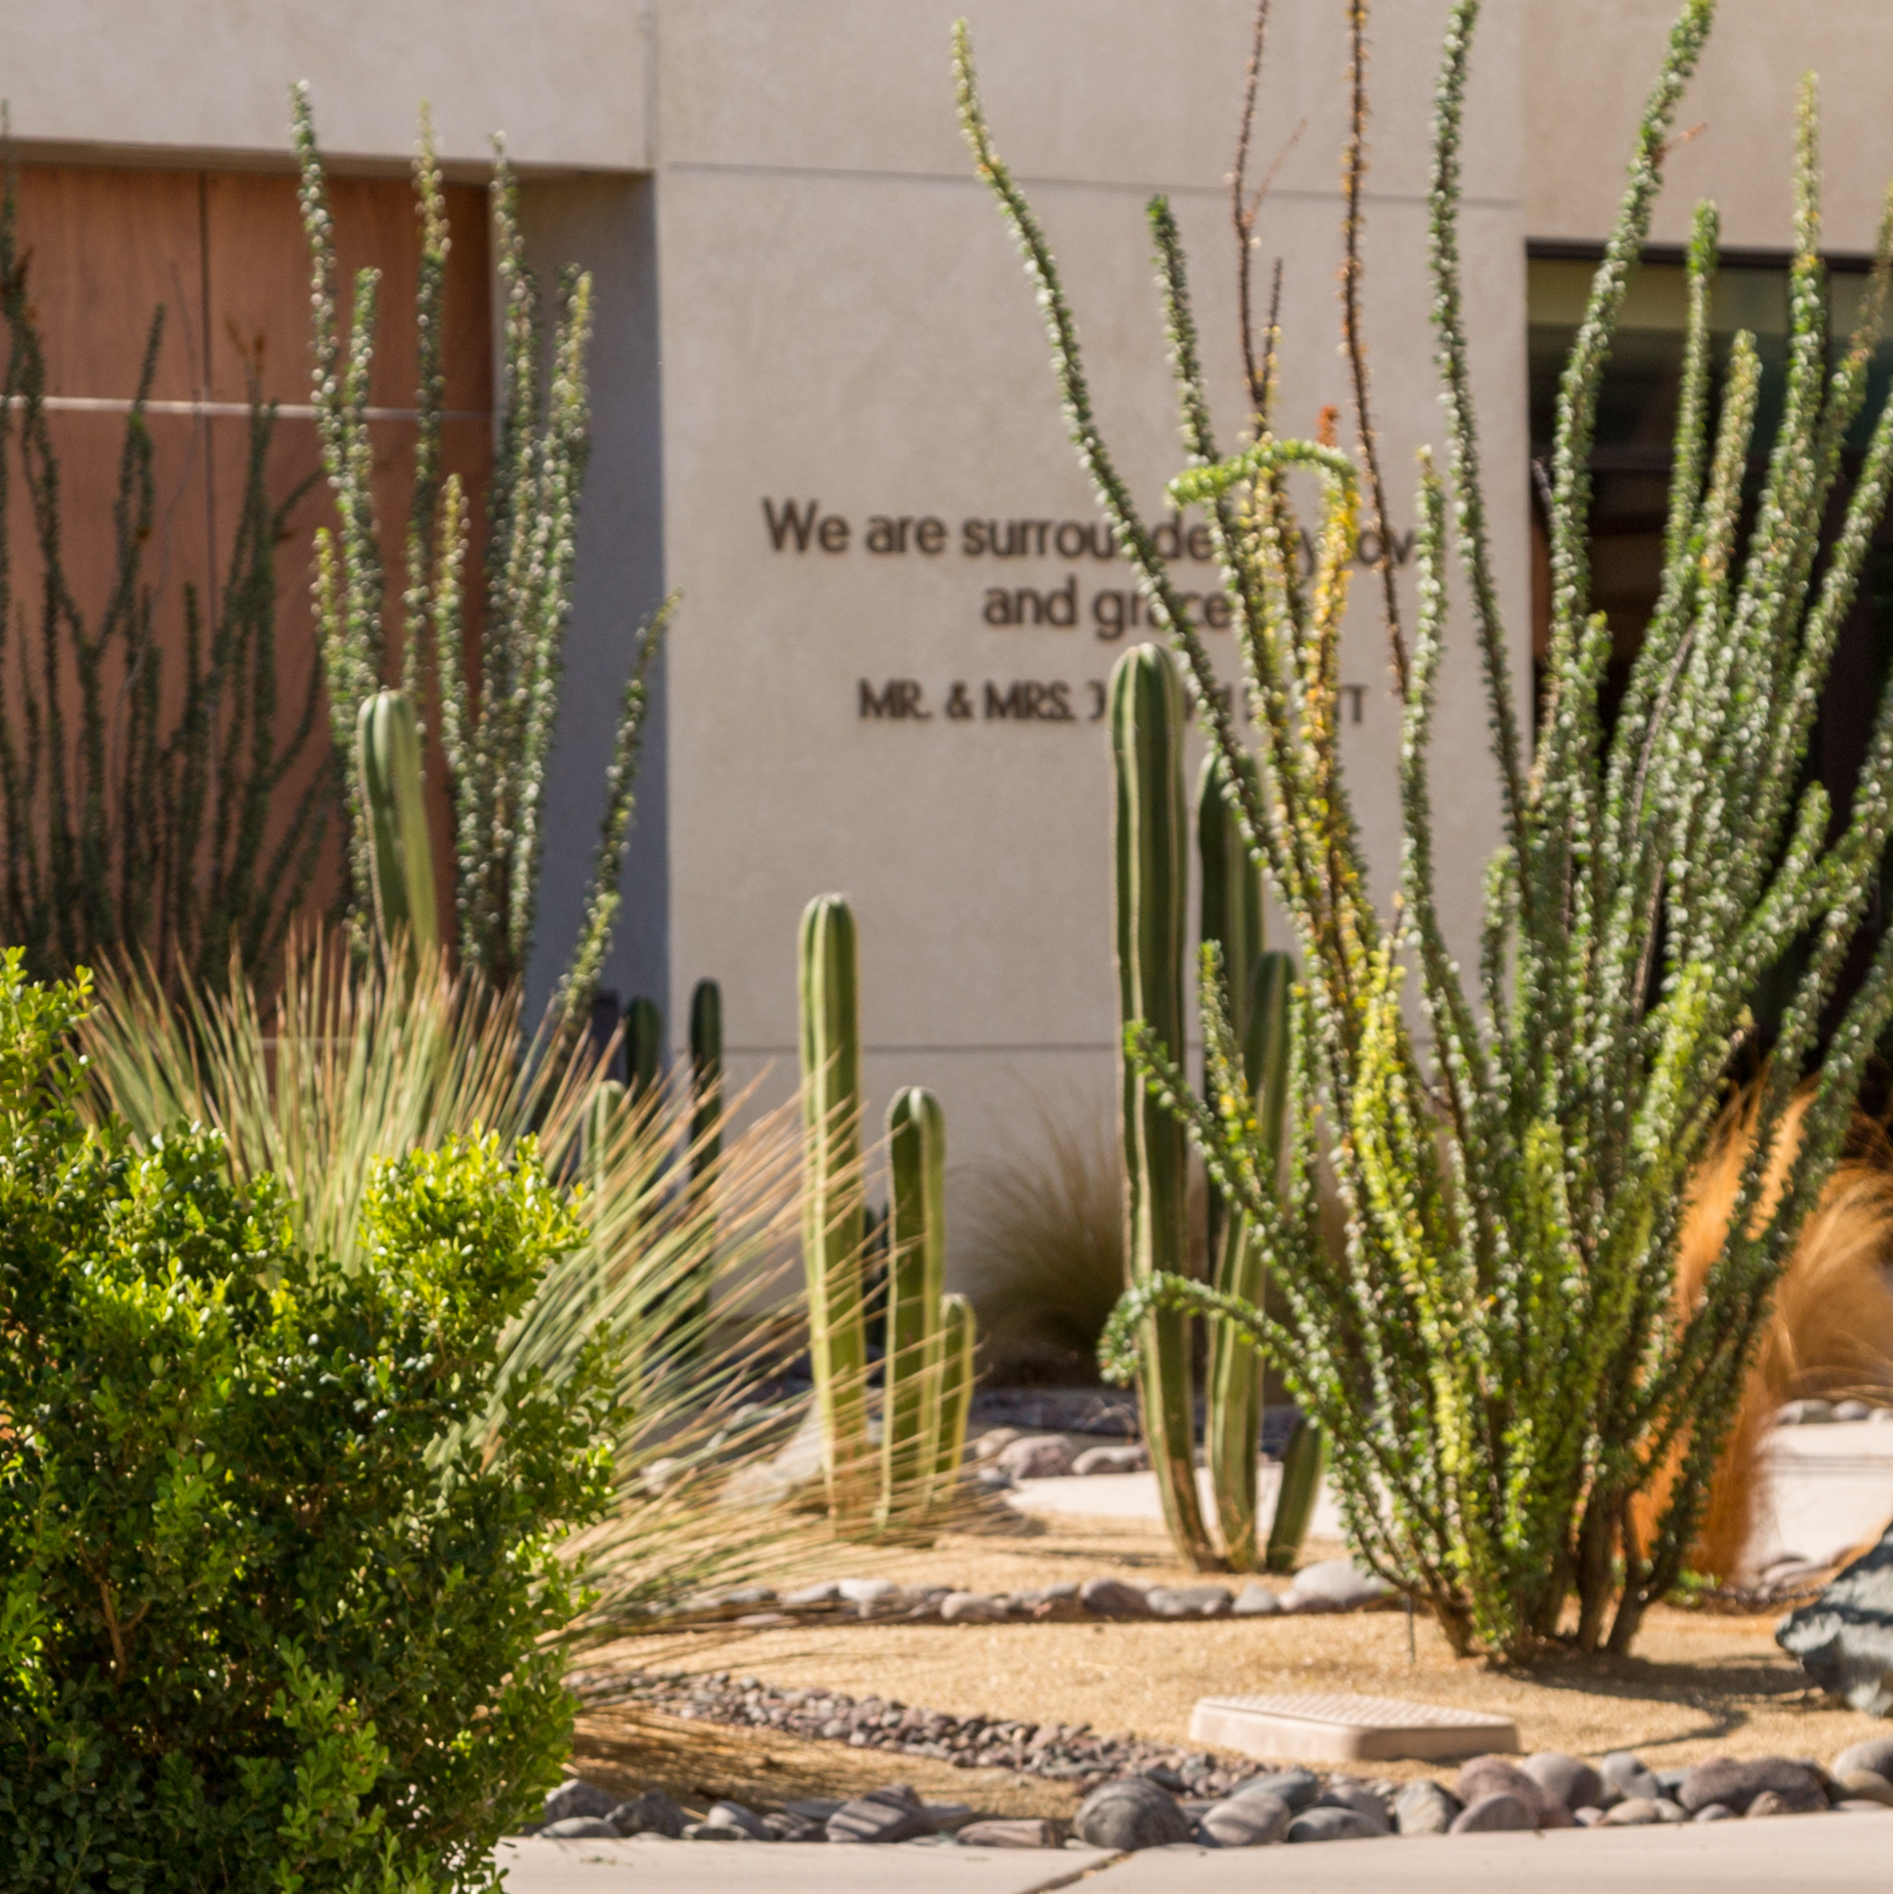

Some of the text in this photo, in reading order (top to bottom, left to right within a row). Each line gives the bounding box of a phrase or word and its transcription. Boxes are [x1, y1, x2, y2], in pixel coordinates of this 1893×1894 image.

[762, 496, 850, 554] We
[865, 515, 949, 554] are
[982, 573, 1079, 627] and
[859, 677, 933, 720] MR.
[944, 680, 974, 719] &
[983, 679, 1076, 722] MRS.
